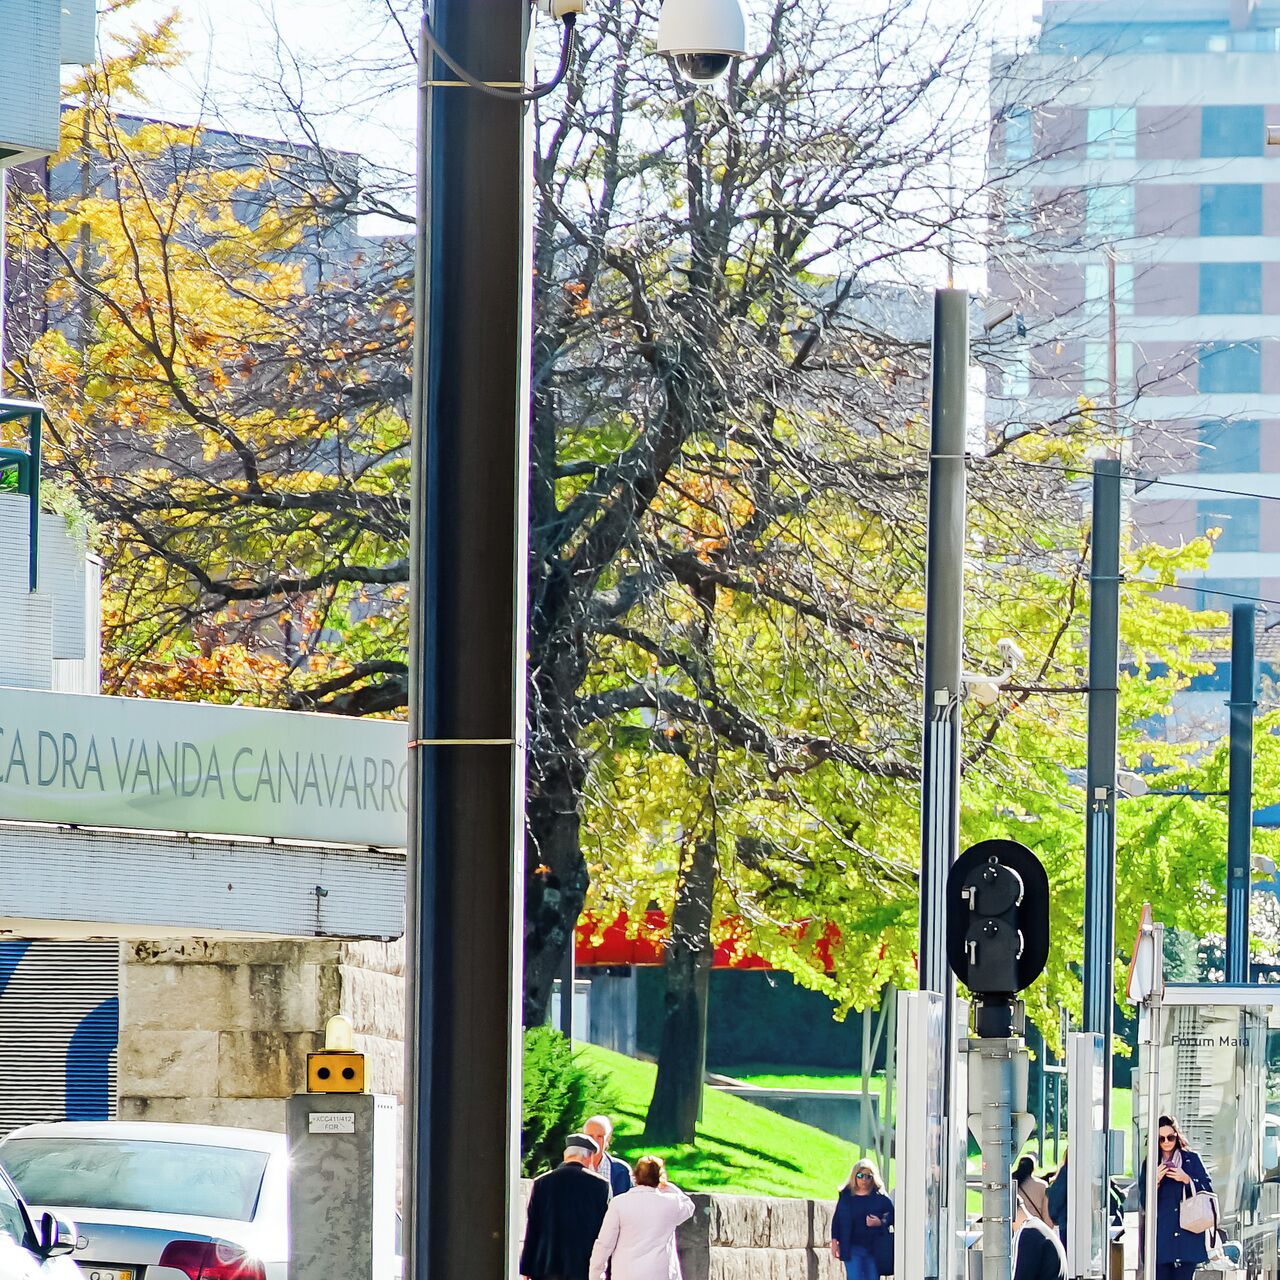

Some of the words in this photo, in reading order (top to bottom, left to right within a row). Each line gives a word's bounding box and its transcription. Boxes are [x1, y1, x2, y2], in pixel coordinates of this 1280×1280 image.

[0, 728, 30, 785] A
[37, 730, 105, 792] DRA
[111, 736, 225, 800] VANDA
[1219, 1035, 1250, 1047] Maia
